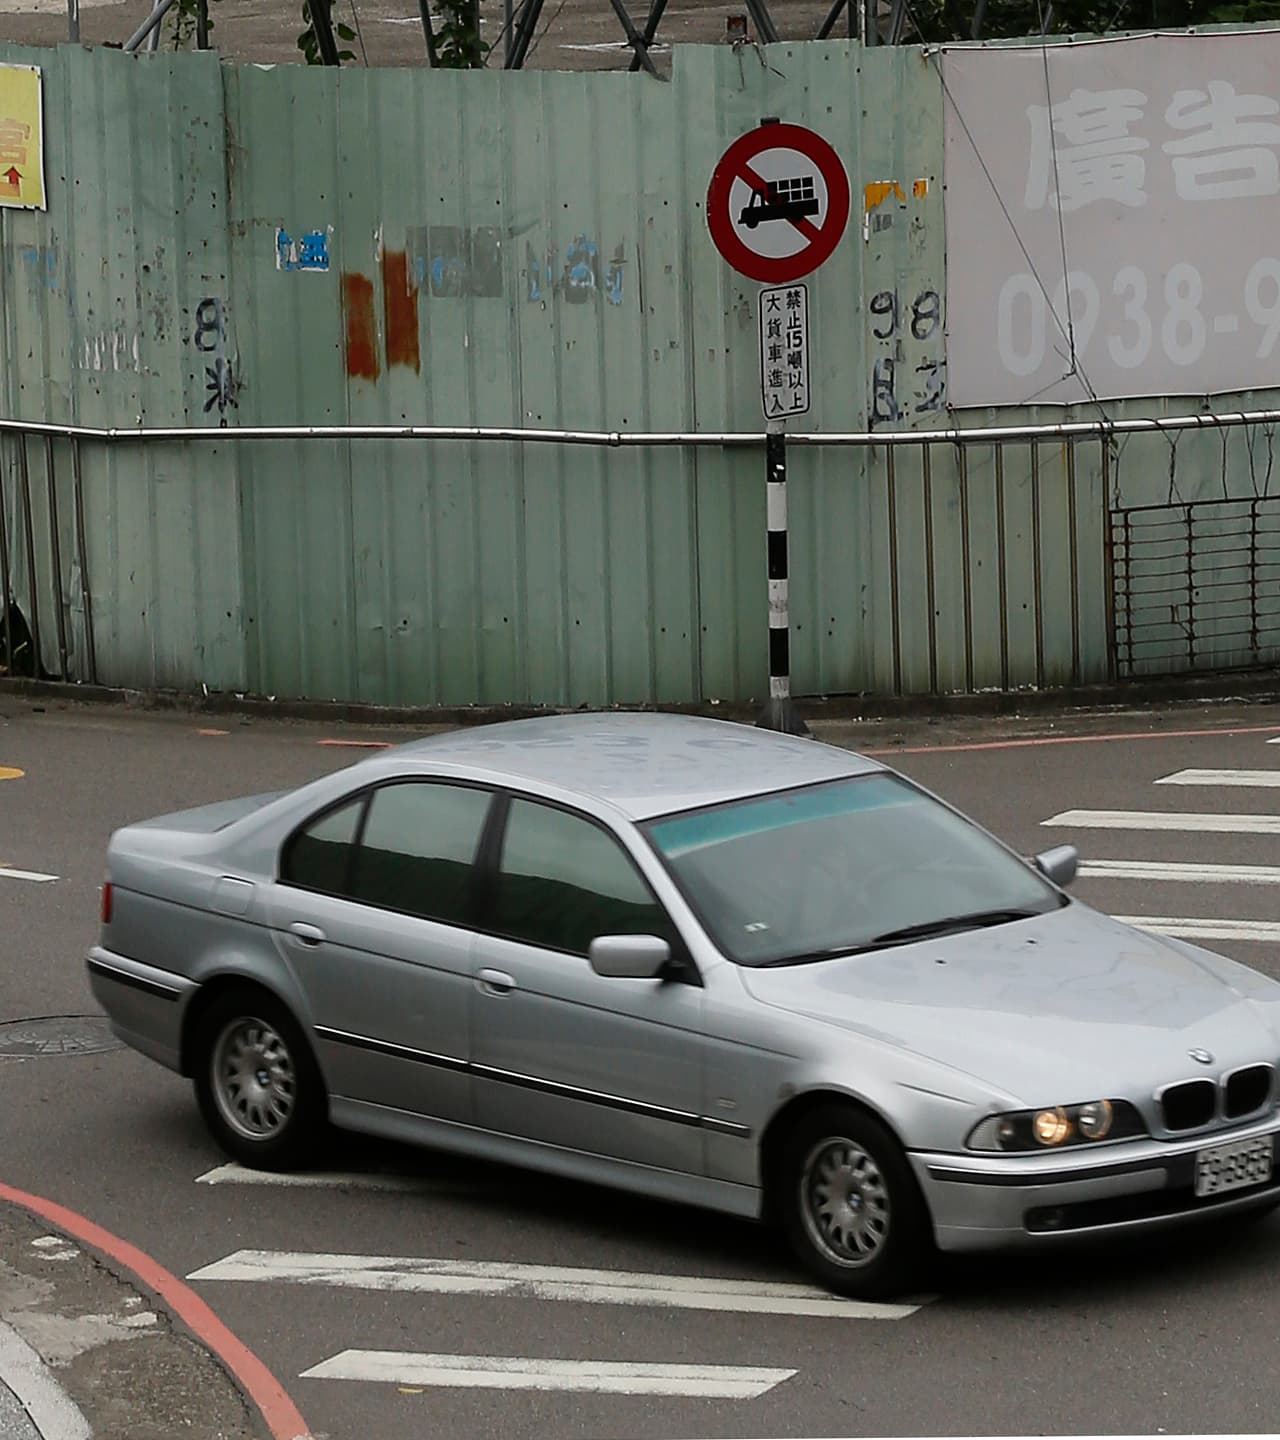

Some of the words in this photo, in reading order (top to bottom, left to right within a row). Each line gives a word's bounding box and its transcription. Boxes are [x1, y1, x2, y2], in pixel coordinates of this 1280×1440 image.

[766, 294, 785, 413] 大貨車進入
[786, 289, 805, 411] 禁止15噸以上
